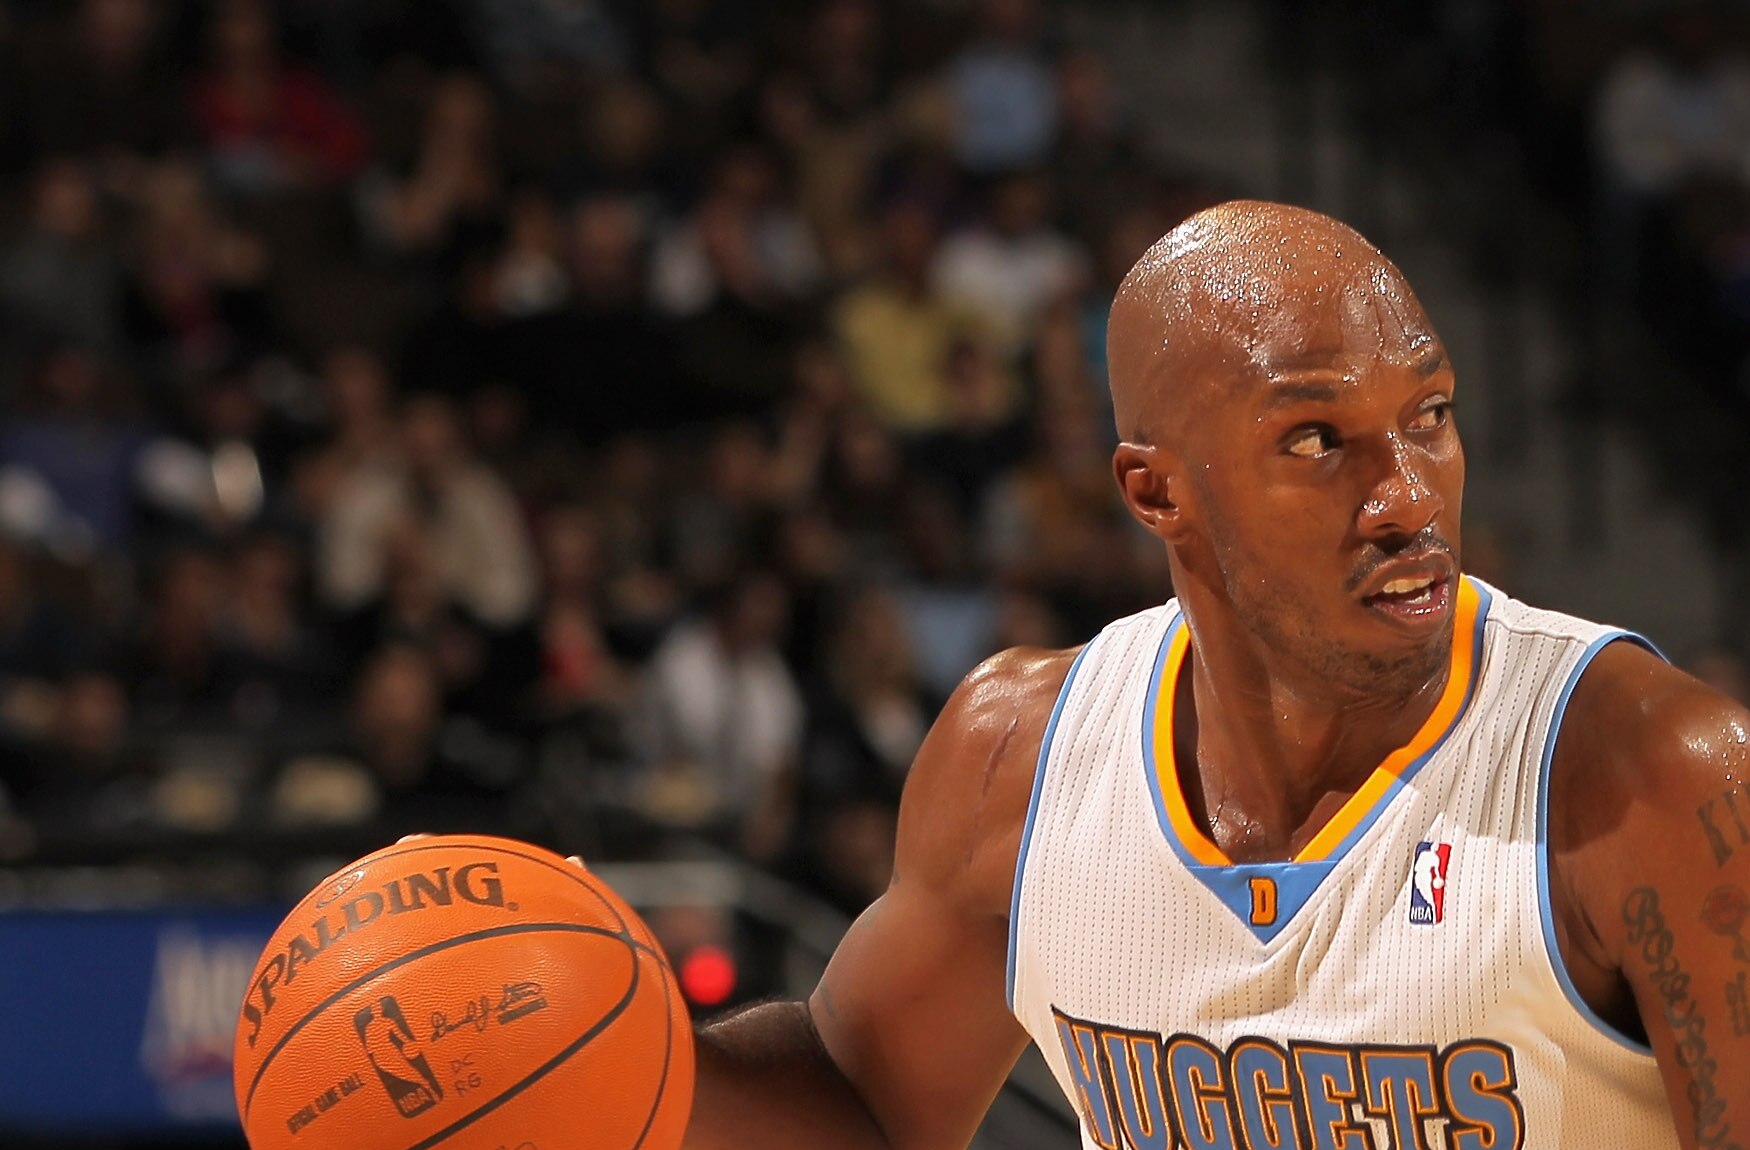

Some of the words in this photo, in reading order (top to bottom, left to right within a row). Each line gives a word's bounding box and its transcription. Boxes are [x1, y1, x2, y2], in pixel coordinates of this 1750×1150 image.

[1248, 876, 1278, 926] D
[1410, 906, 1433, 921] NBA
[243, 862, 506, 1048] SPALDING
[399, 1087, 435, 1114] NBA
